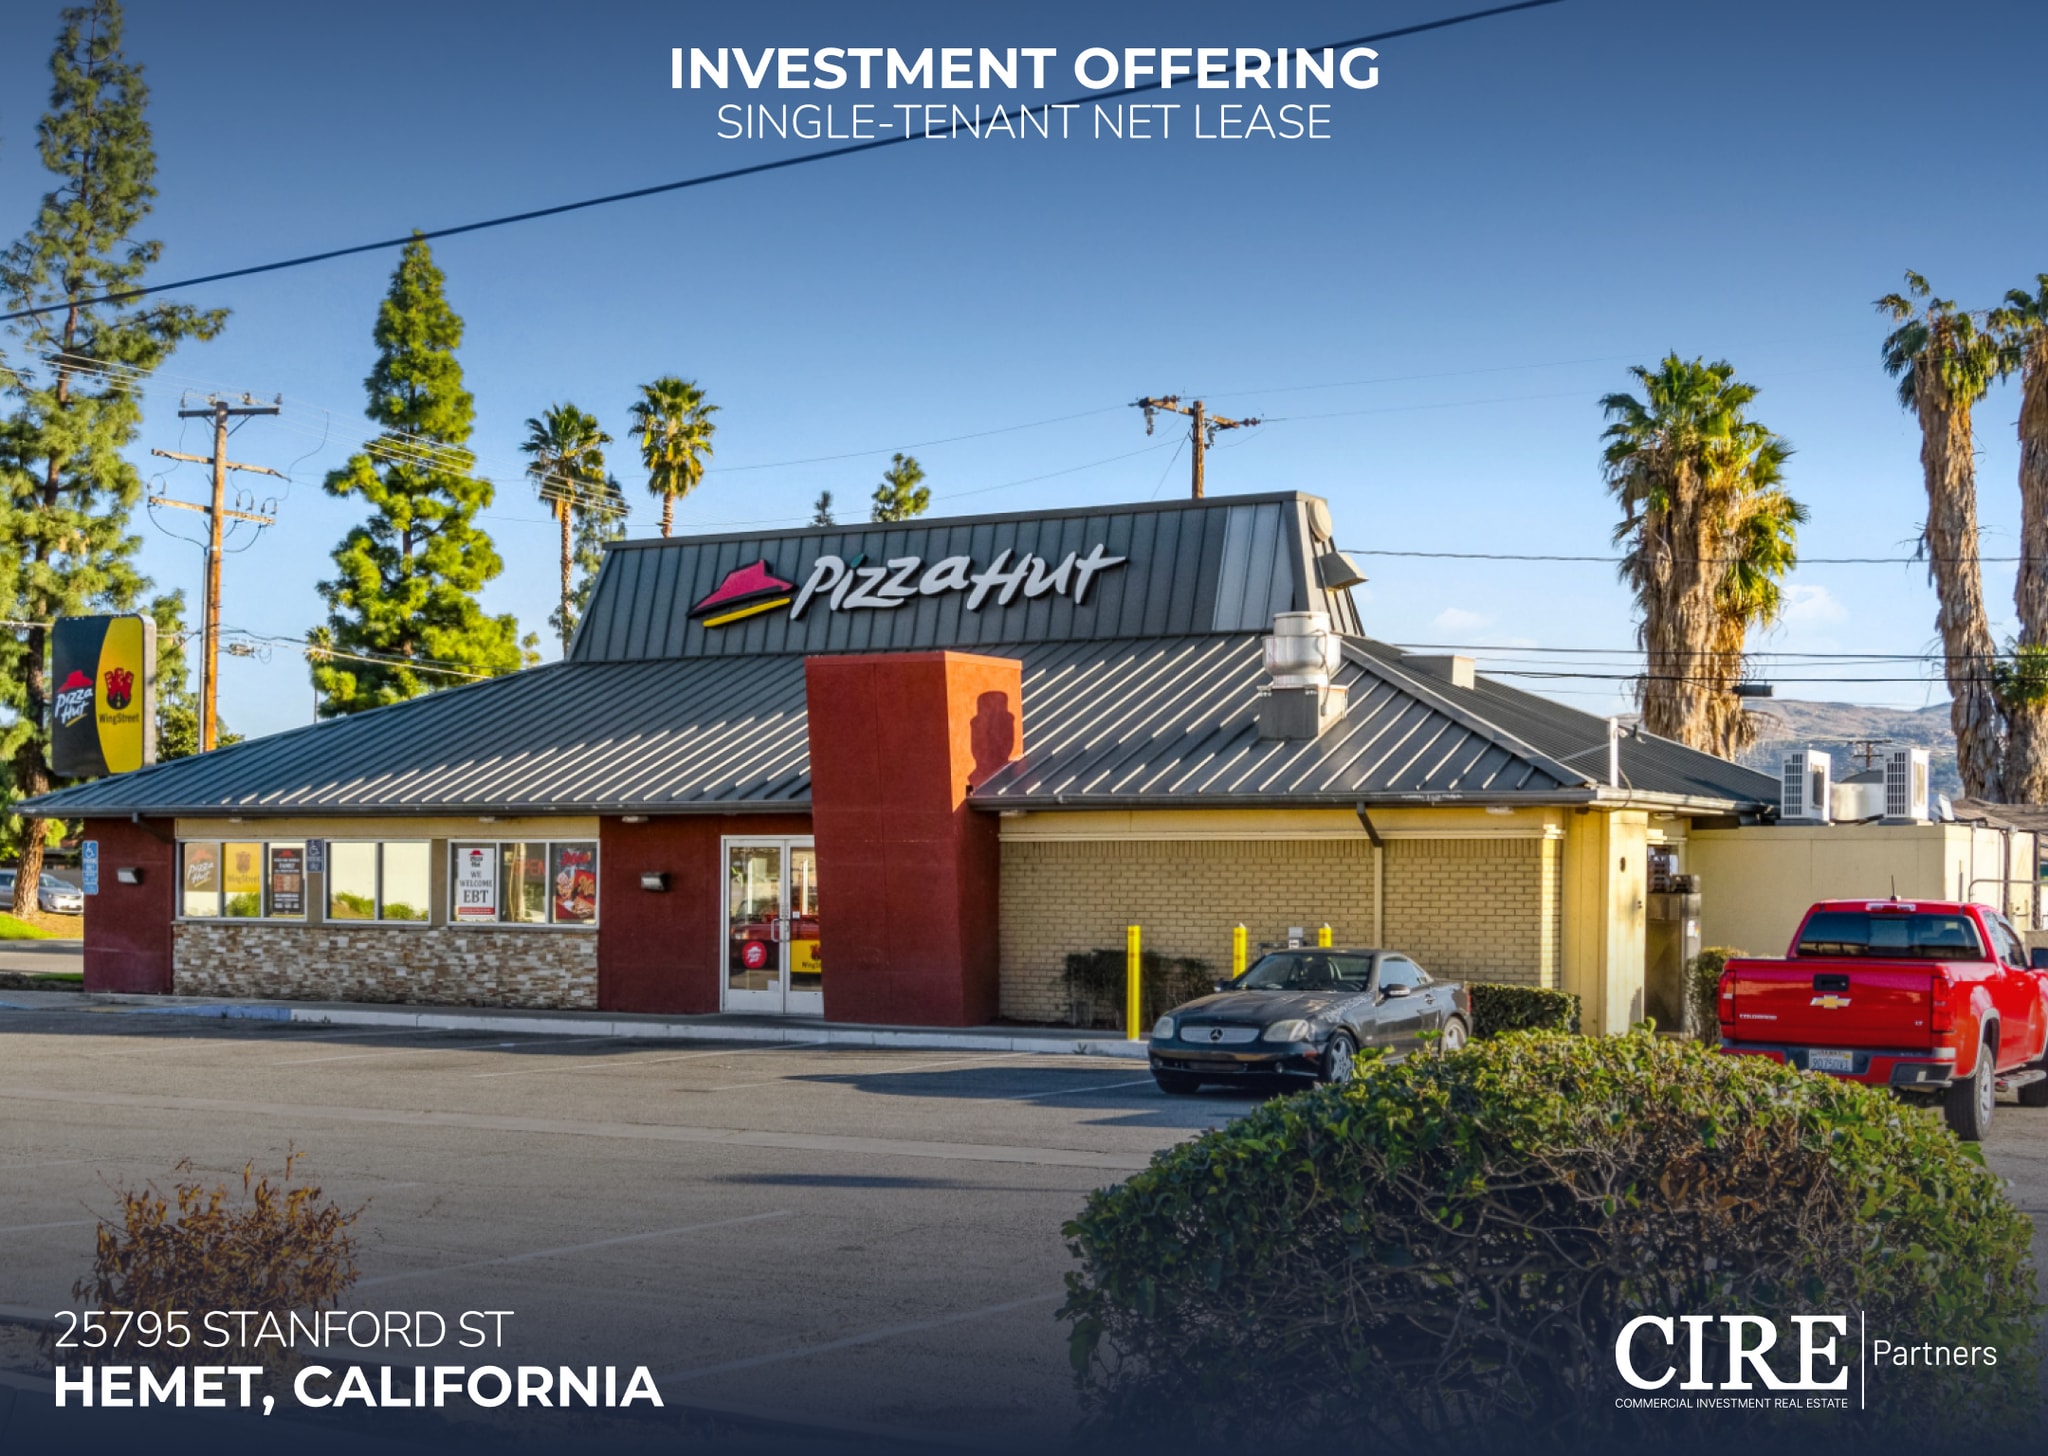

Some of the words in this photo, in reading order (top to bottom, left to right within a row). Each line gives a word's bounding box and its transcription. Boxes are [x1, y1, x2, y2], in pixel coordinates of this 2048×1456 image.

[790, 553, 971, 620] Pizza
[966, 543, 1127, 611] Hut
[54, 688, 93, 718] Pizza
[61, 700, 89, 724] Hut
[99, 713, 140, 725] WingStreet
[187, 862, 214, 880] Pizza
[192, 870, 211, 883] Hut
[459, 880, 492, 888] WELCOME
[463, 890, 488, 903] EBT
